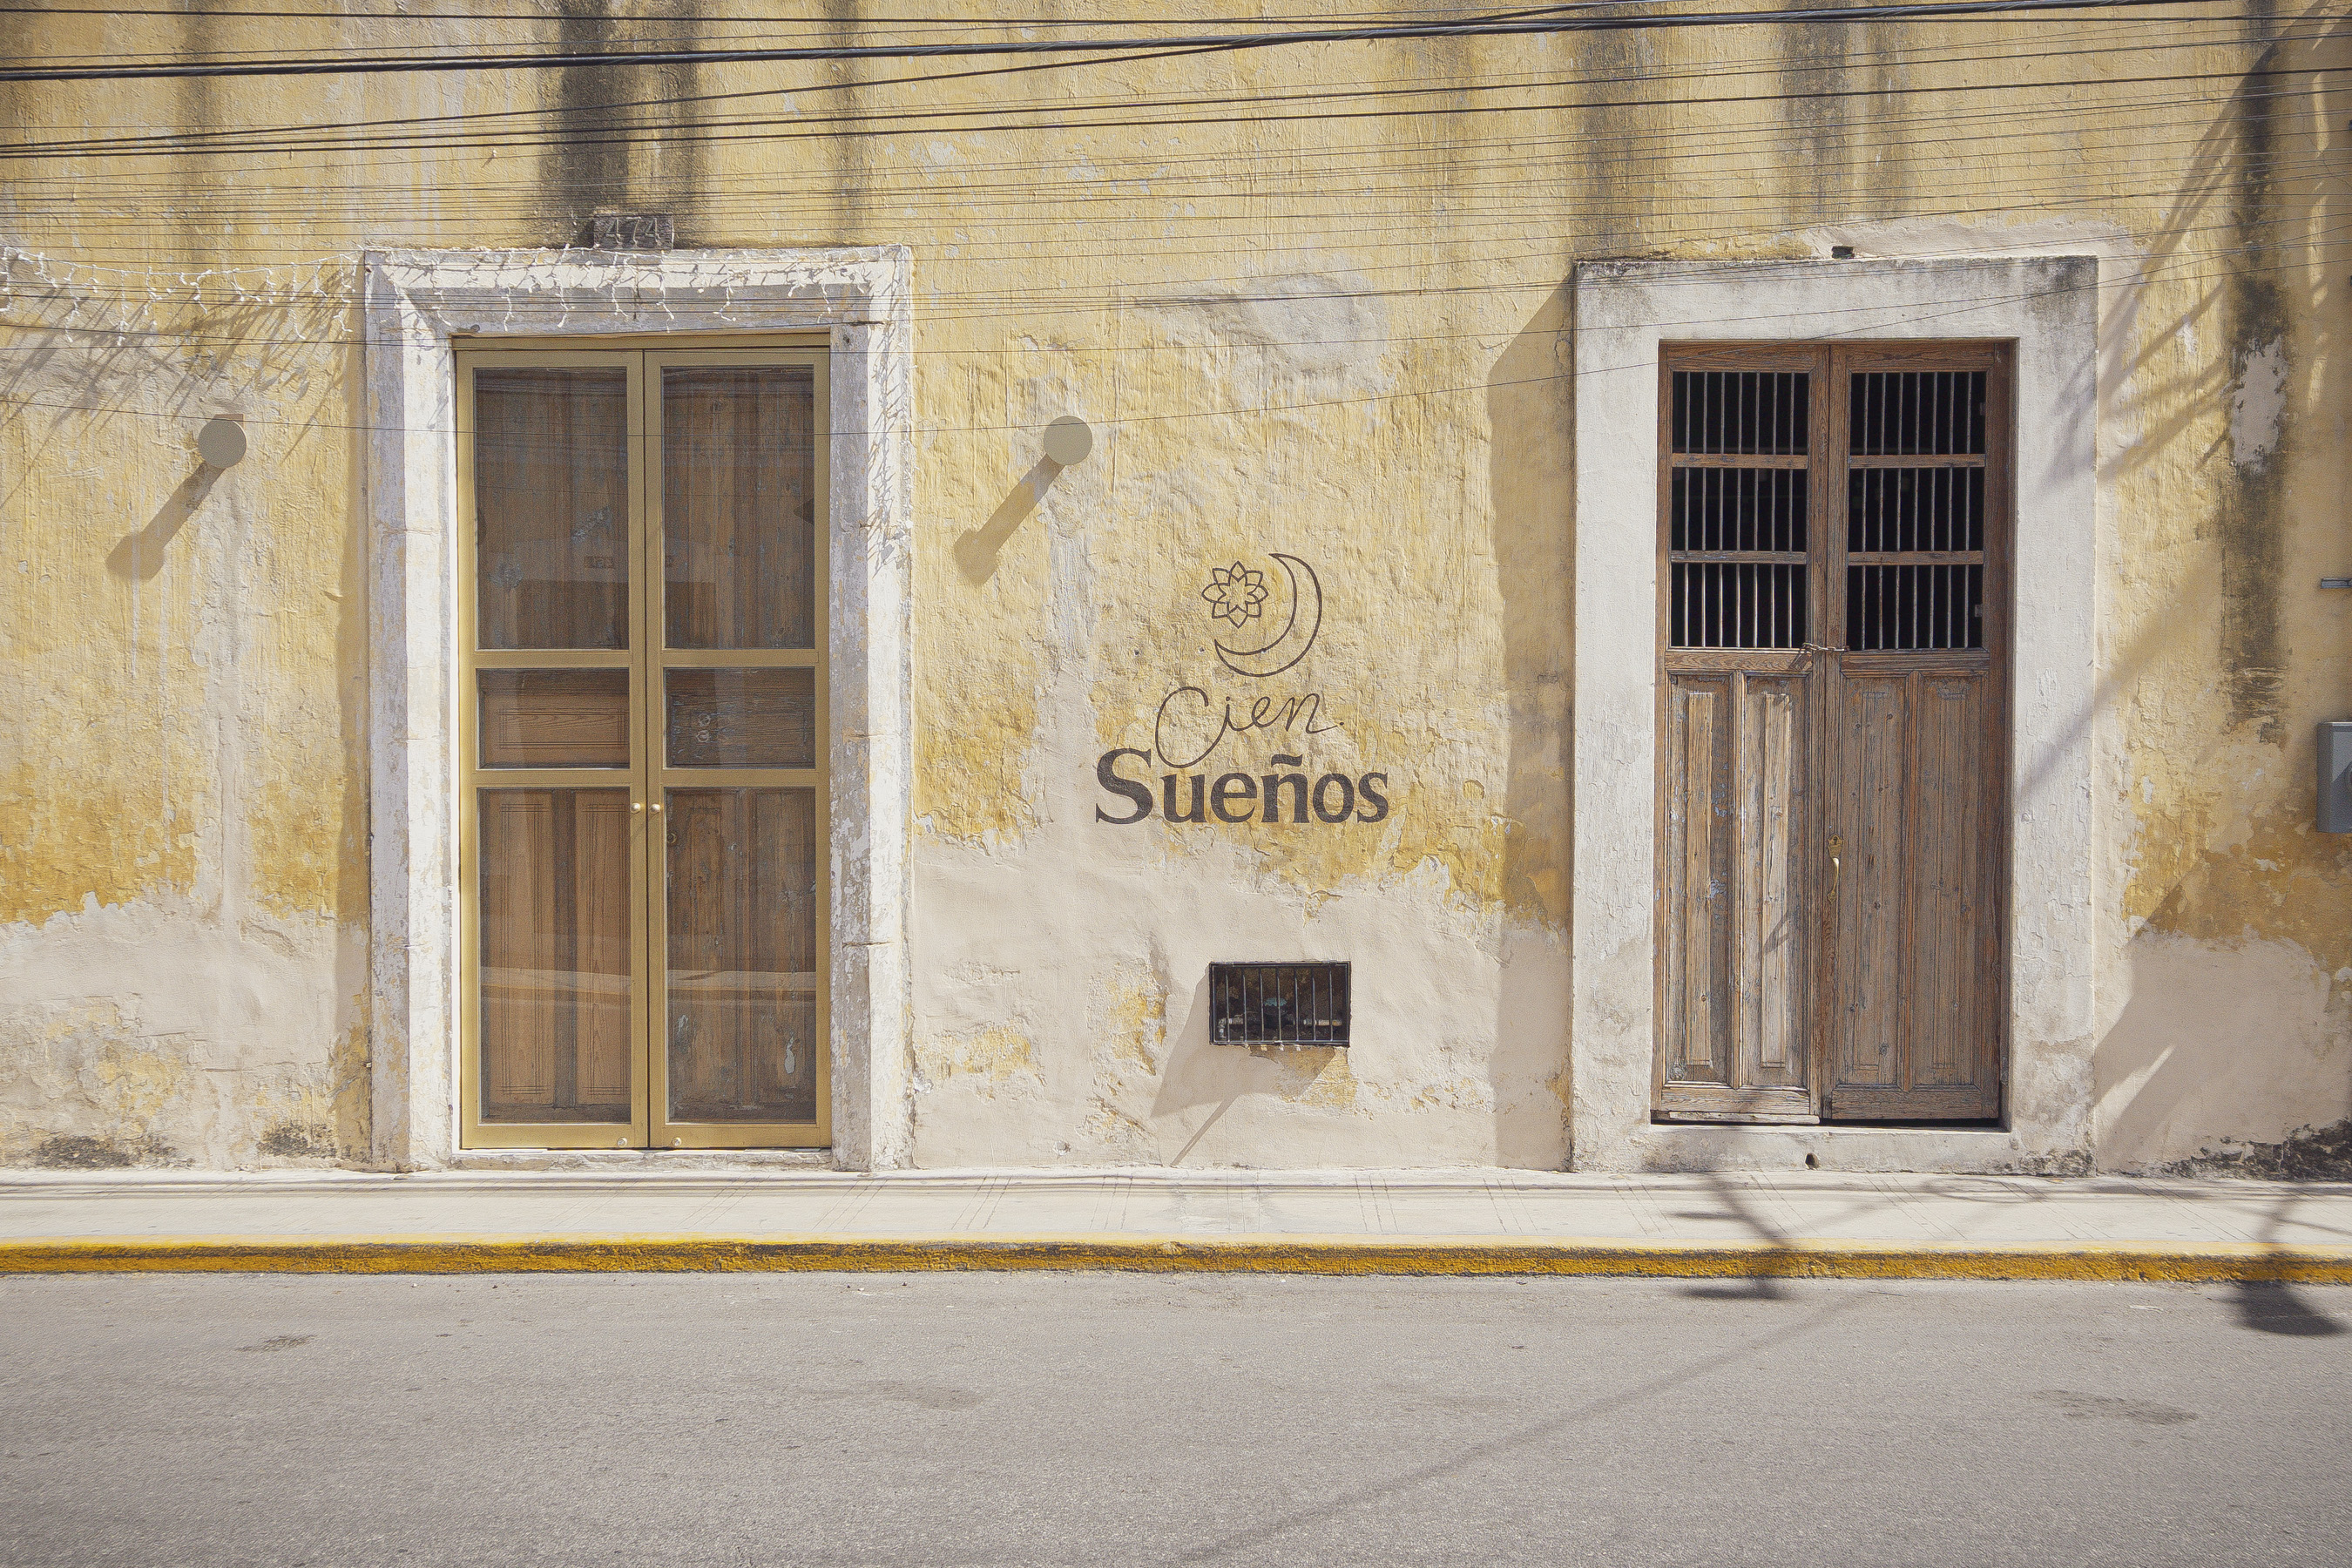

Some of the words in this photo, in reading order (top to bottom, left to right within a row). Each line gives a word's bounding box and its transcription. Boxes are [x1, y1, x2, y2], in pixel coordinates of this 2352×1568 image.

[604, 216, 662, 248] 474
[1155, 686, 1344, 768] Cien
[1095, 747, 1389, 825] Sueños
